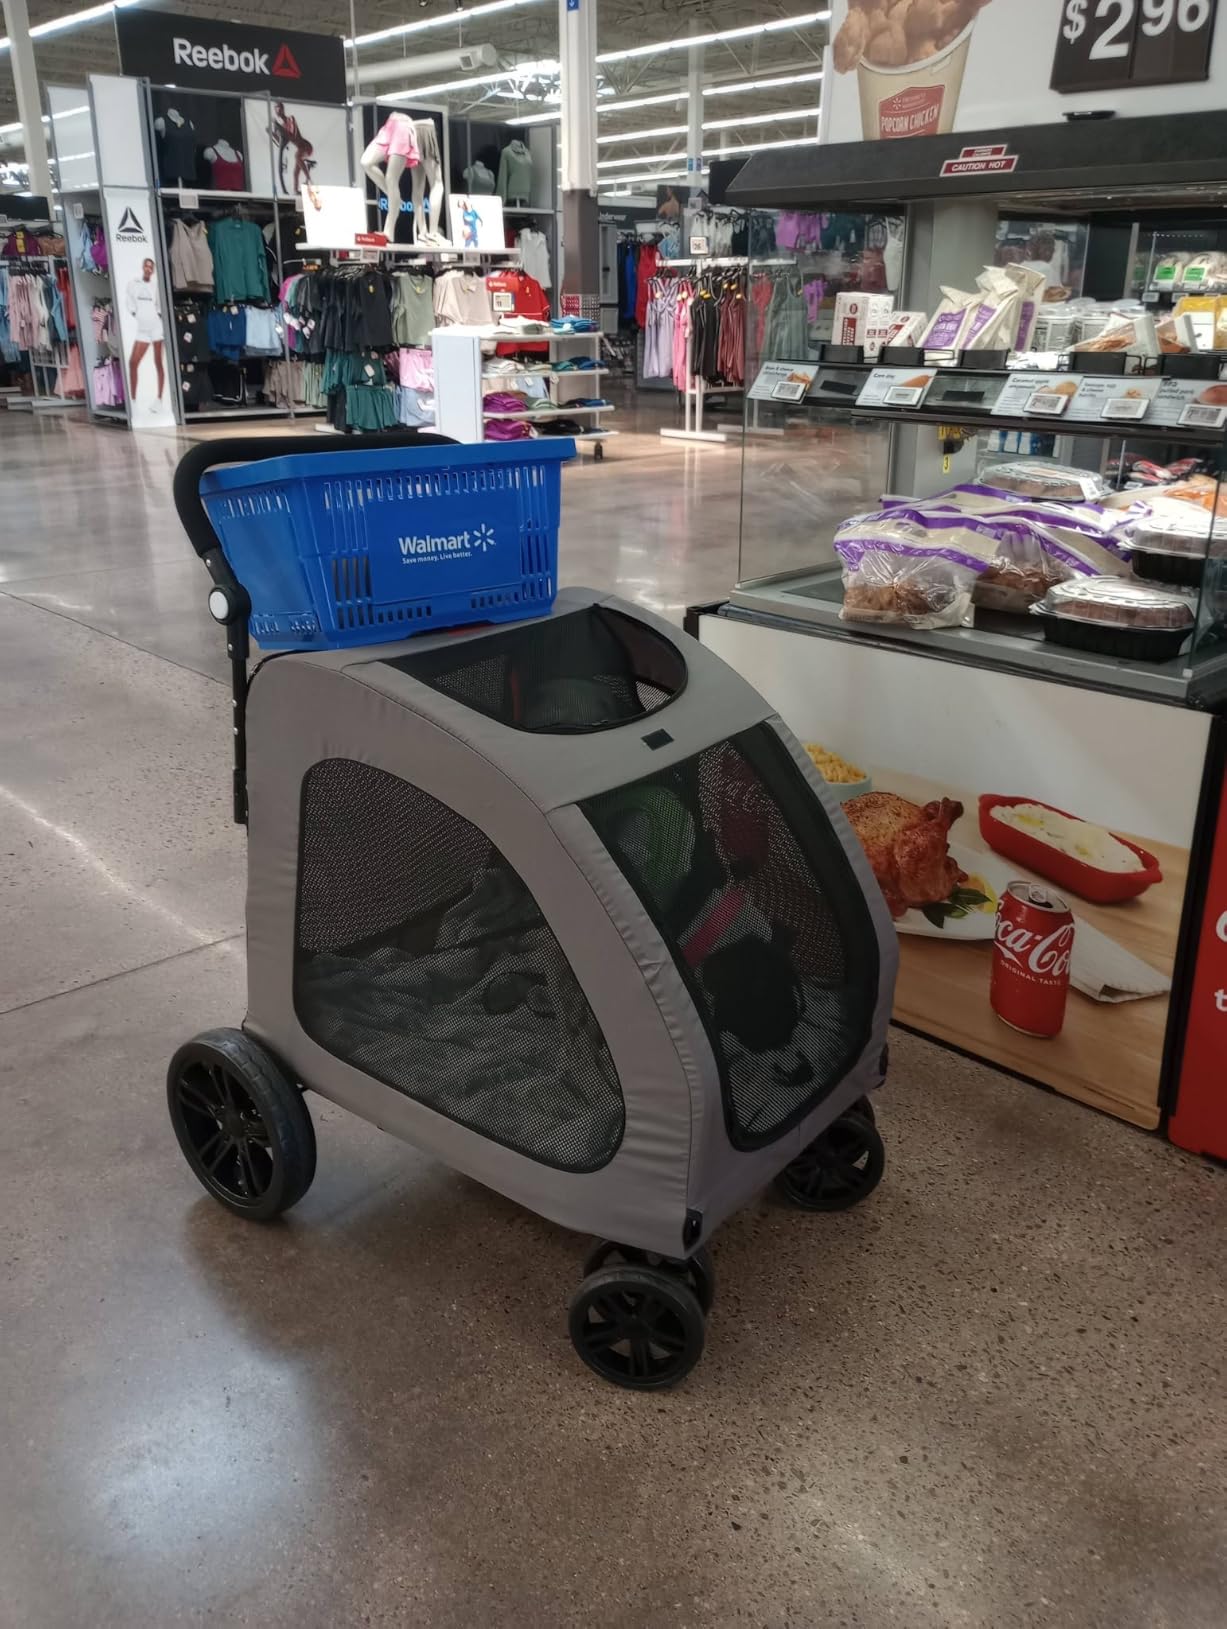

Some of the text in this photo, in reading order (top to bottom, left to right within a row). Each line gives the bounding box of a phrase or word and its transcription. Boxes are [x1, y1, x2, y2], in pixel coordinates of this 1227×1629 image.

[173, 37, 270, 75] Reebok
[881, 104, 940, 133] POPCORN CHICKEN
[951, 161, 1006, 172] CAUTION HOT
[116, 233, 148, 243] Reebok
[398, 531, 471, 555] Walmart
[453, 551, 472, 559] better.
[1001, 960, 1036, 982] ORIGINAL
